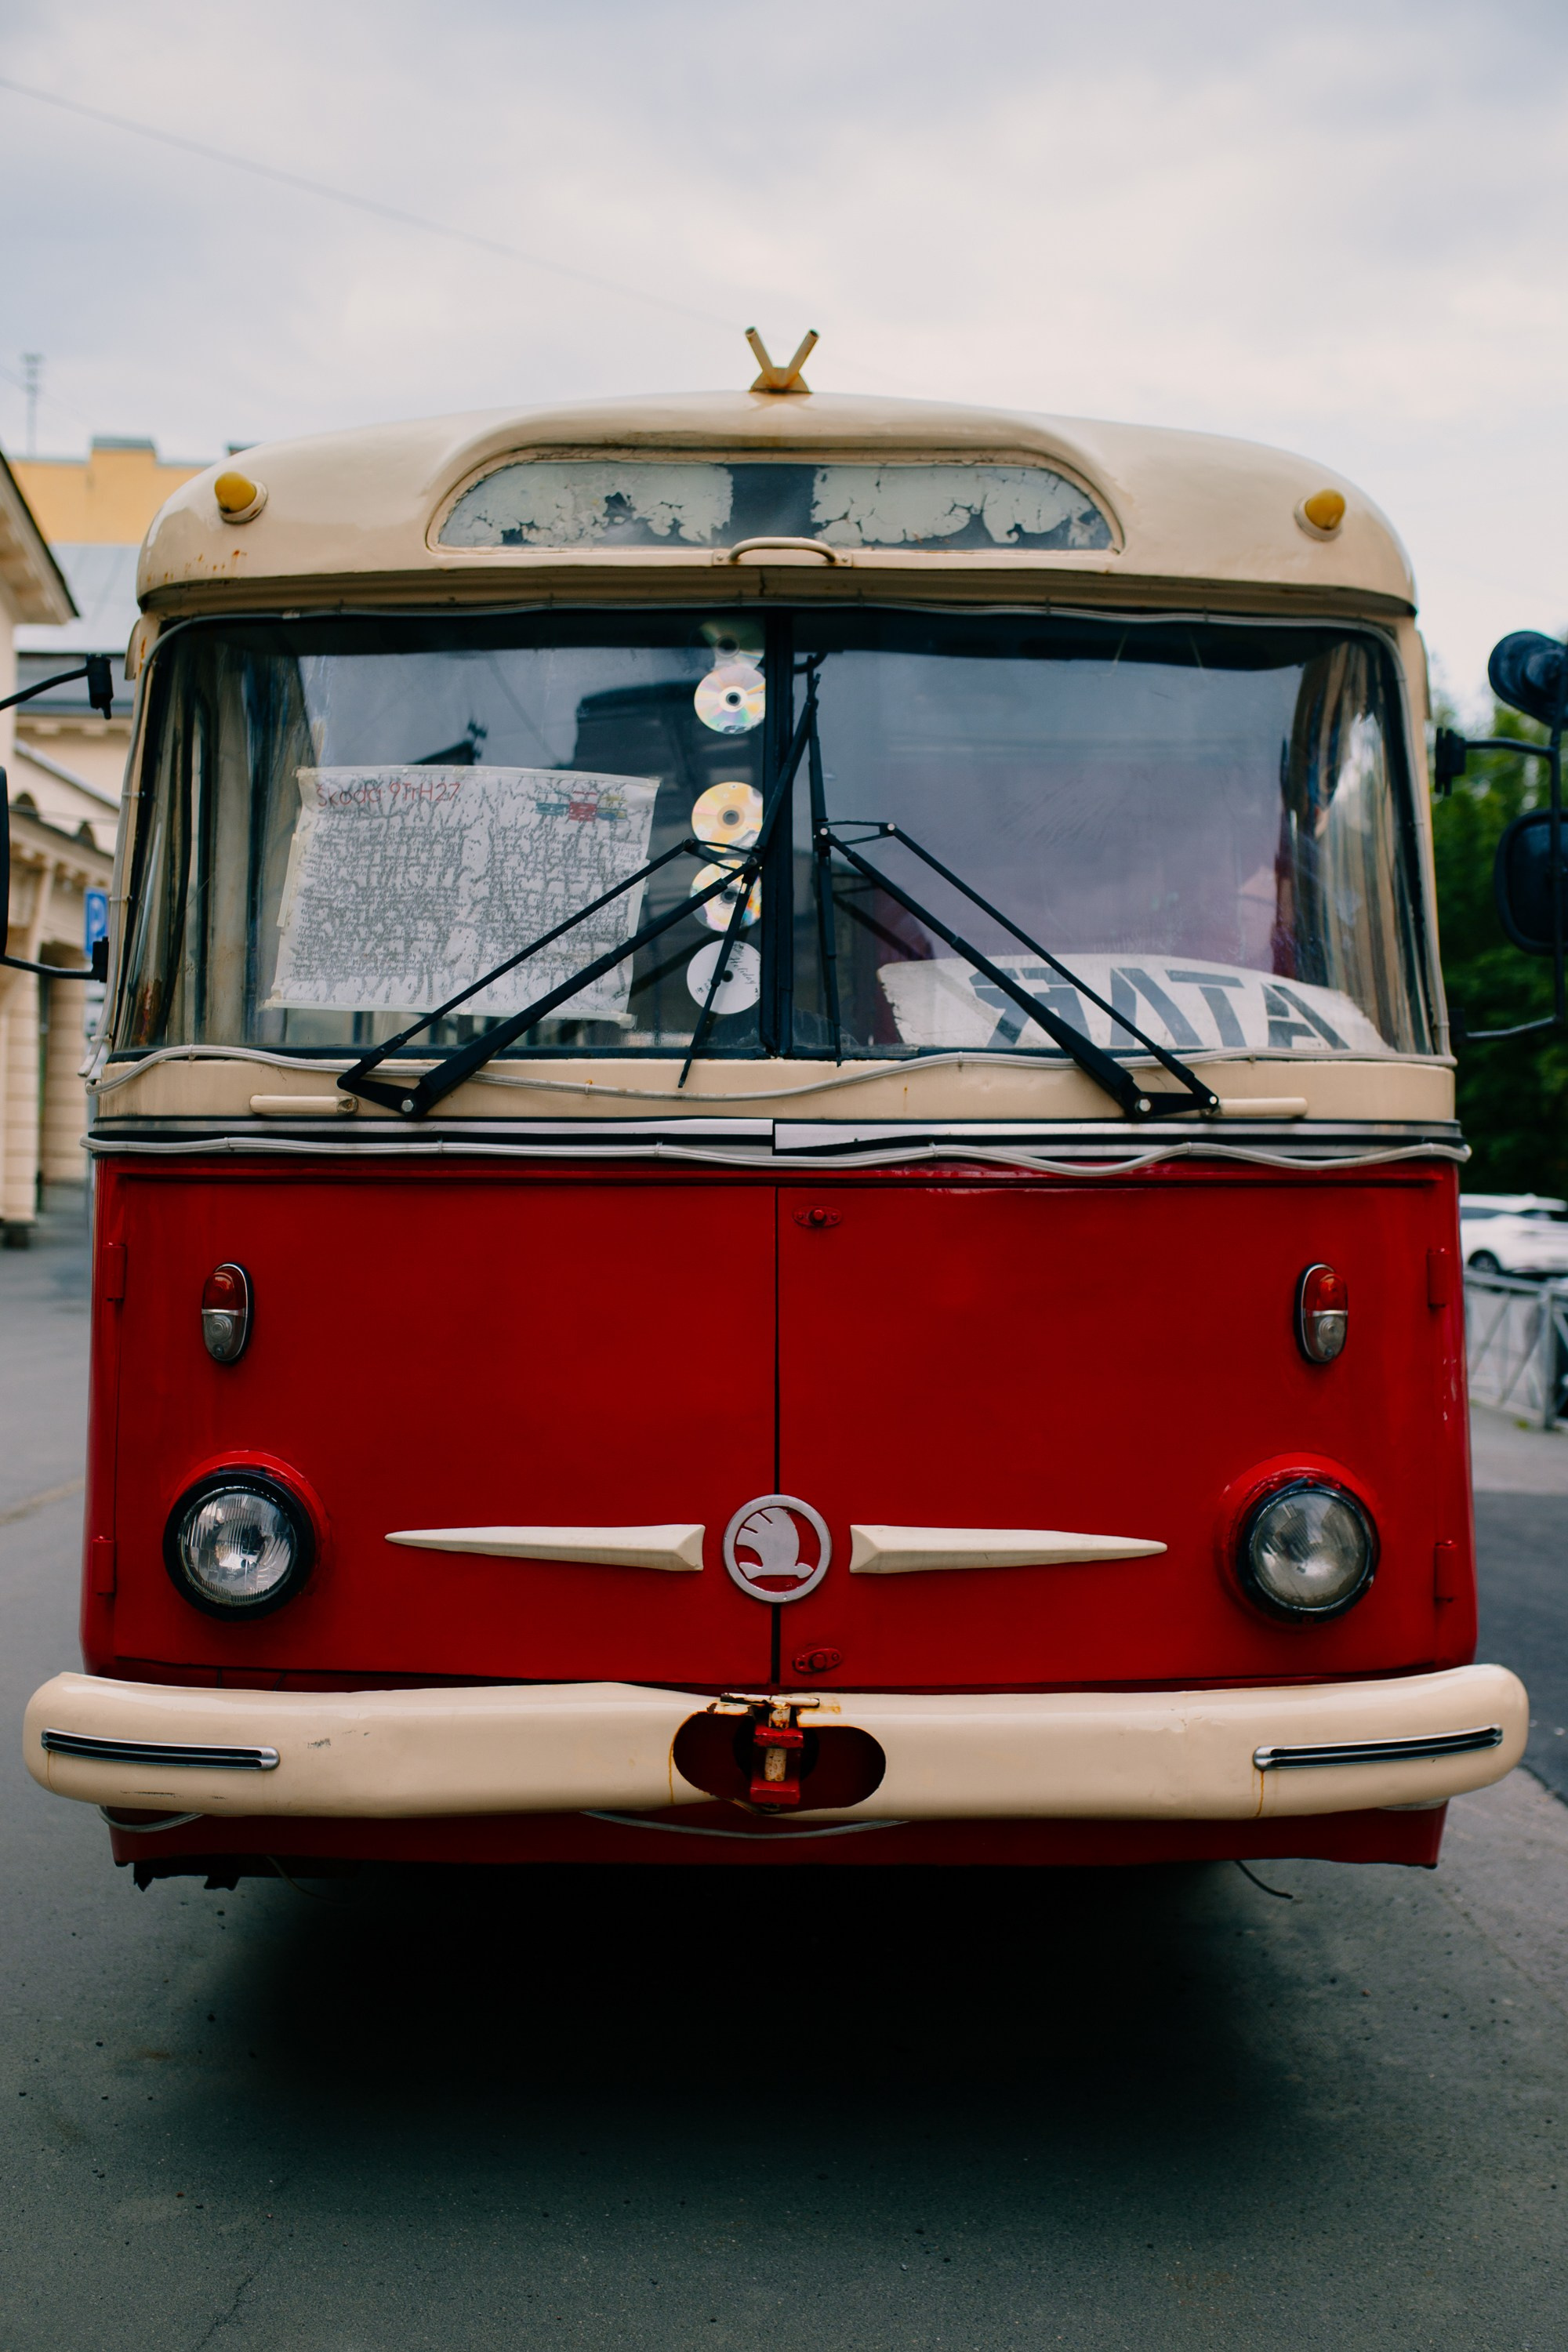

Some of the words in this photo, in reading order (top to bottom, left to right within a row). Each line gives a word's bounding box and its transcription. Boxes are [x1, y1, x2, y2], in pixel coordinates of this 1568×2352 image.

[316, 784, 382, 807] Škoda
[728, 957, 757, 985] Holiday
[969, 967, 1351, 1050] ЯЛТА
